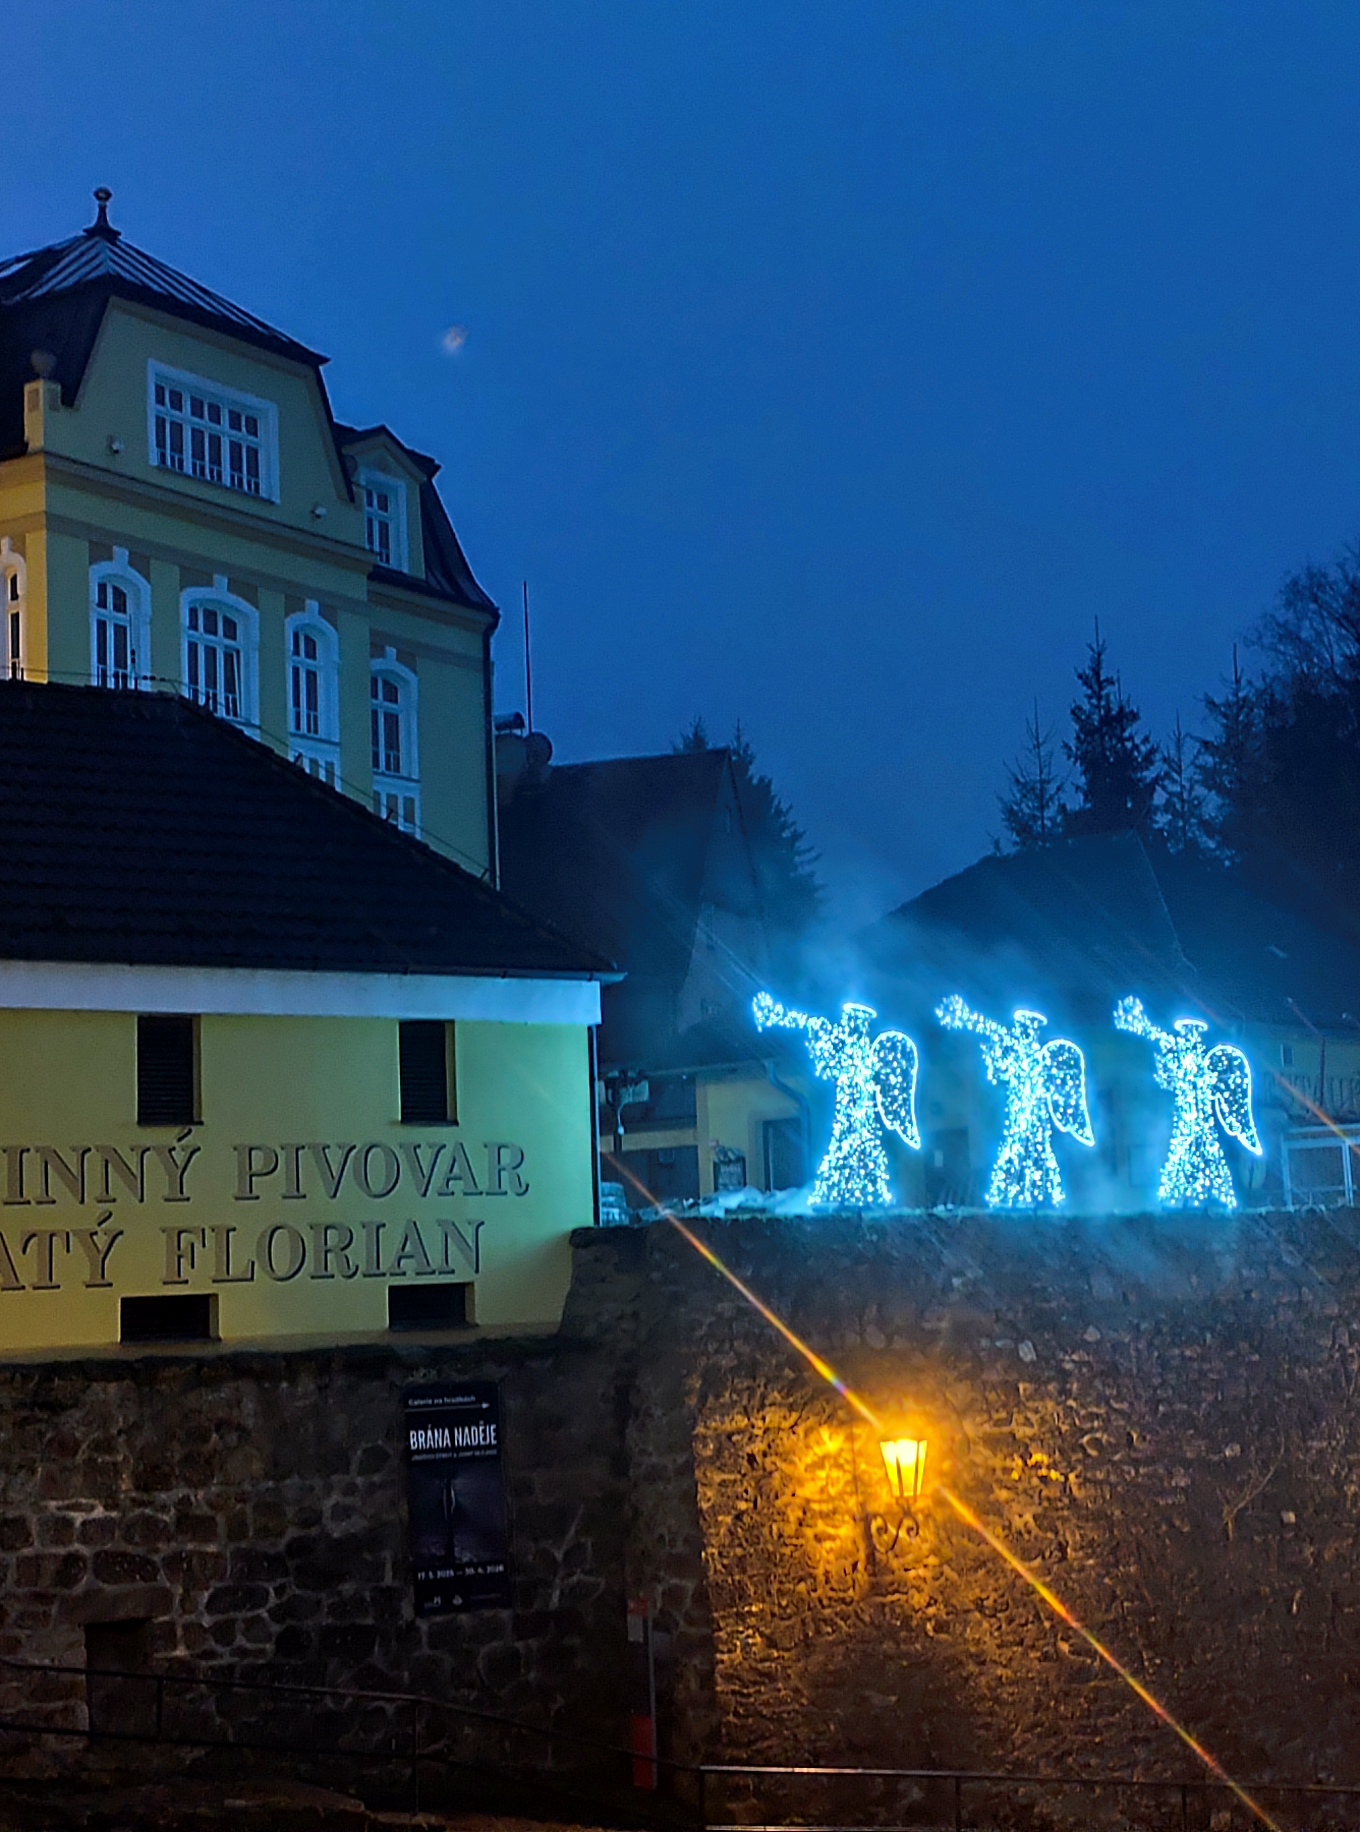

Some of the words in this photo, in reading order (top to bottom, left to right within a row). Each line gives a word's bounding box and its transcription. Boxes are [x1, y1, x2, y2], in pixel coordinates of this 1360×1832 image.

[233, 1142, 530, 1200] PIVOVAR
[160, 1218, 485, 1285] FLORIAN
[409, 1423, 452, 1451] BRÁNA
[454, 1420, 498, 1448] NADĚJE
